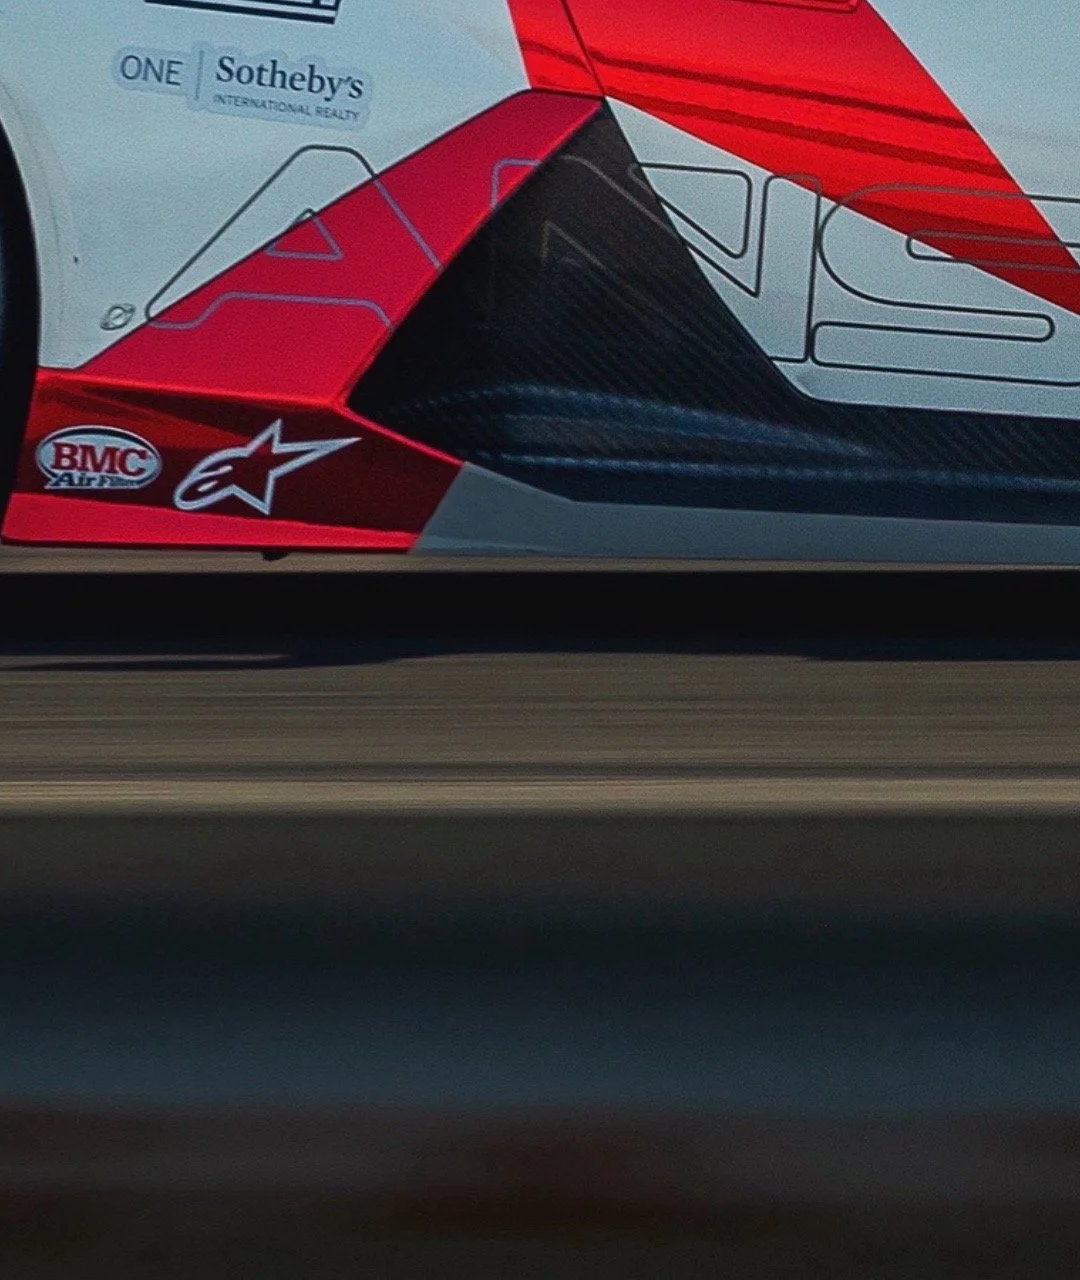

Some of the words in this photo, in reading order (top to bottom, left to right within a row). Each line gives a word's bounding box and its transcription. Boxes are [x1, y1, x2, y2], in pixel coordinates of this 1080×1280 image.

[120, 54, 184, 86] ONE
[215, 55, 364, 102] Sotheby's
[213, 93, 311, 117] INTERNATIONAL
[315, 105, 361, 122] REALTY
[50, 441, 148, 477] BMC
